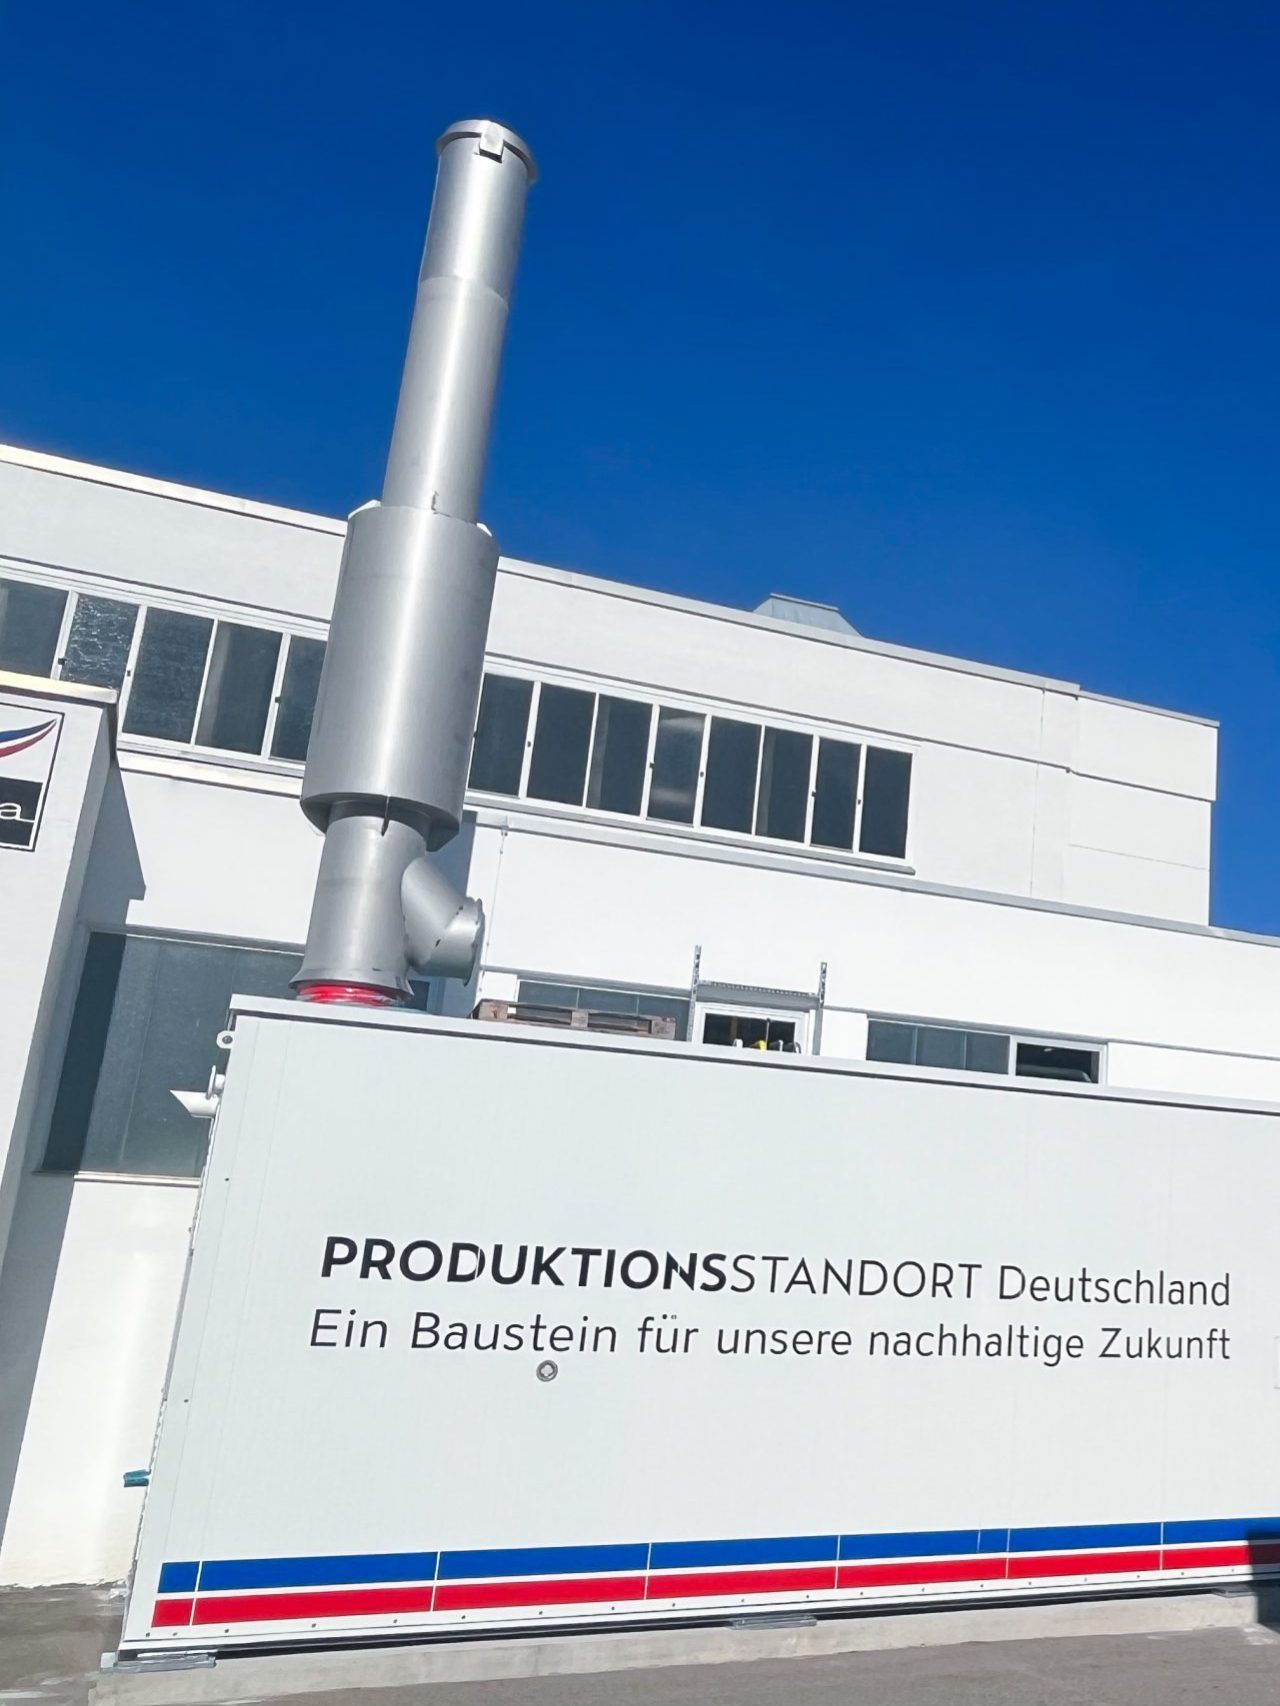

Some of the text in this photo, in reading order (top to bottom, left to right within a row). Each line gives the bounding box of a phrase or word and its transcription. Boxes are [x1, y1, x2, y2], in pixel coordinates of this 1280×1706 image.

[320, 1235, 1231, 1306] PRODUKTIONSSTANDORT Deutschland
[309, 1308, 1231, 1367] Ein Baustein für unsere nachhaltige Zukunft
